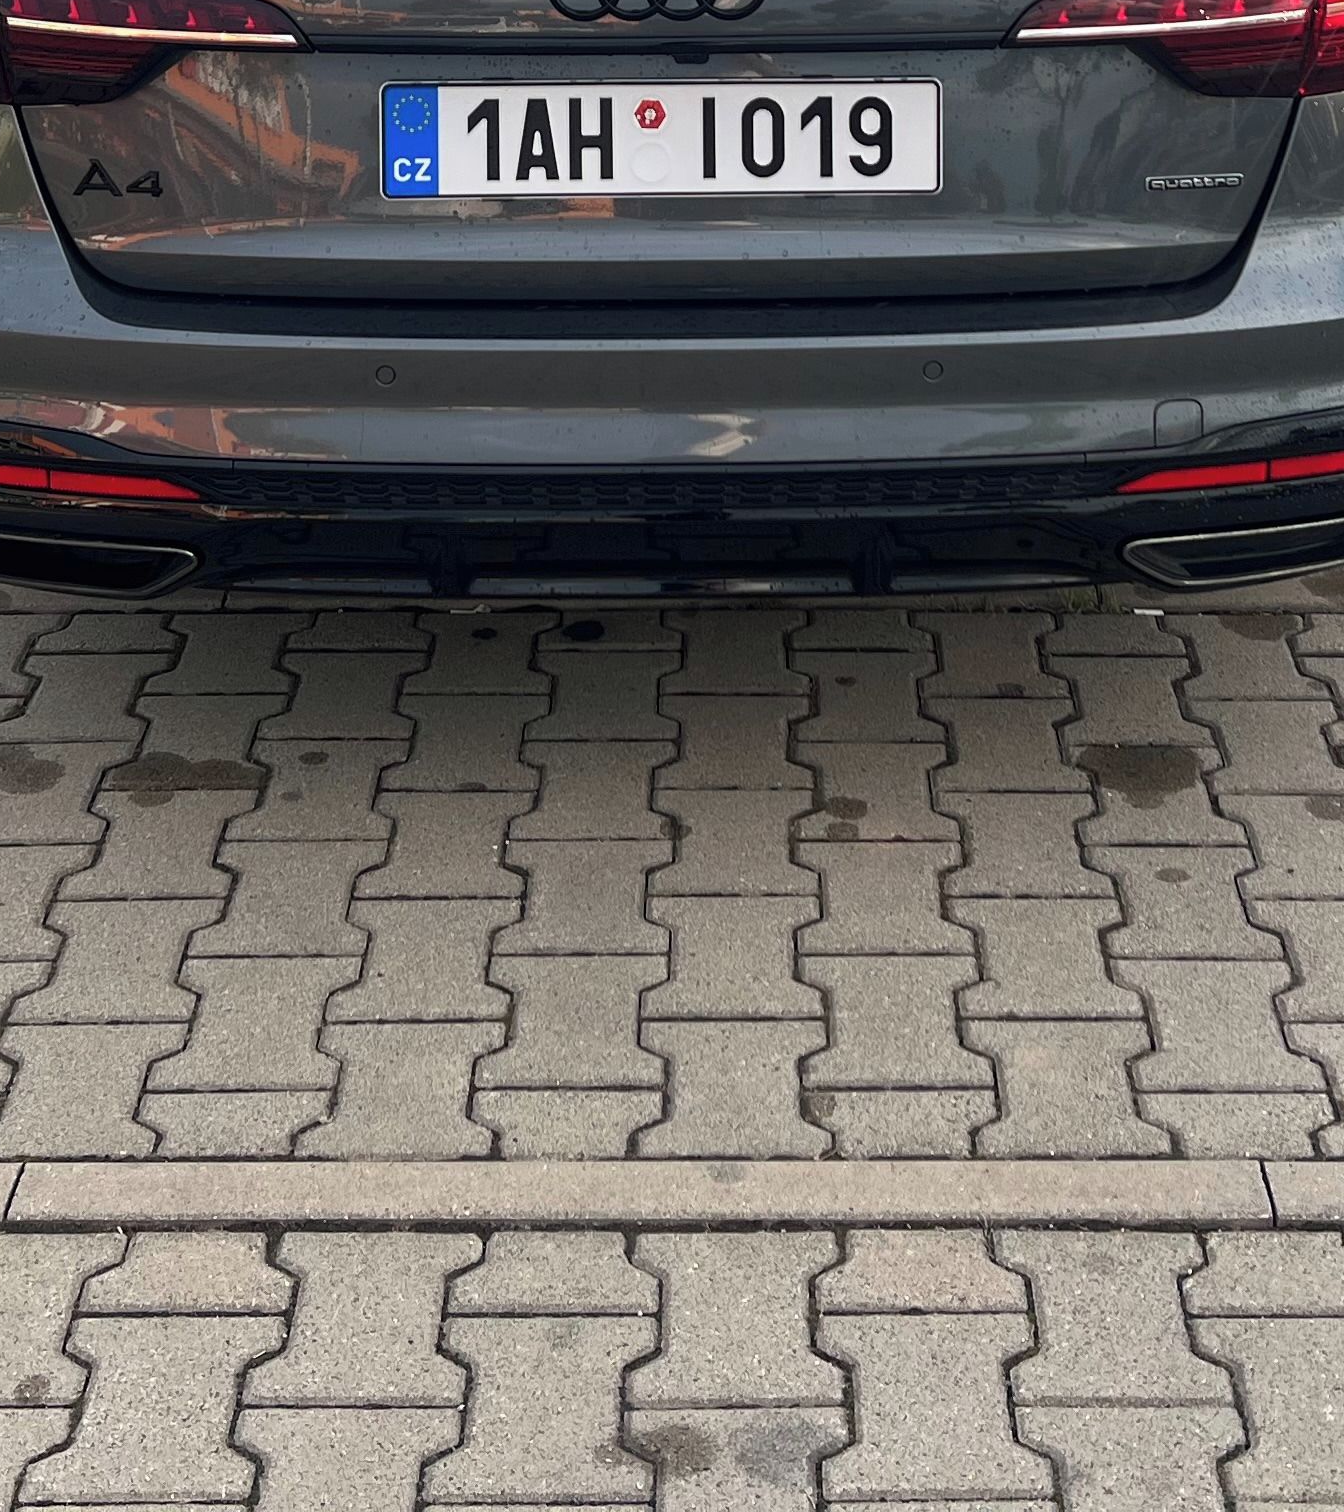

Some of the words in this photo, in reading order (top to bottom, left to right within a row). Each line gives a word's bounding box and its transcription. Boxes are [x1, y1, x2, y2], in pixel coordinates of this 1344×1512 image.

[467, 97, 614, 181] 1AH
[72, 158, 164, 198] A4
[393, 157, 432, 182] CZ
[1149, 175, 1241, 191] quattro
